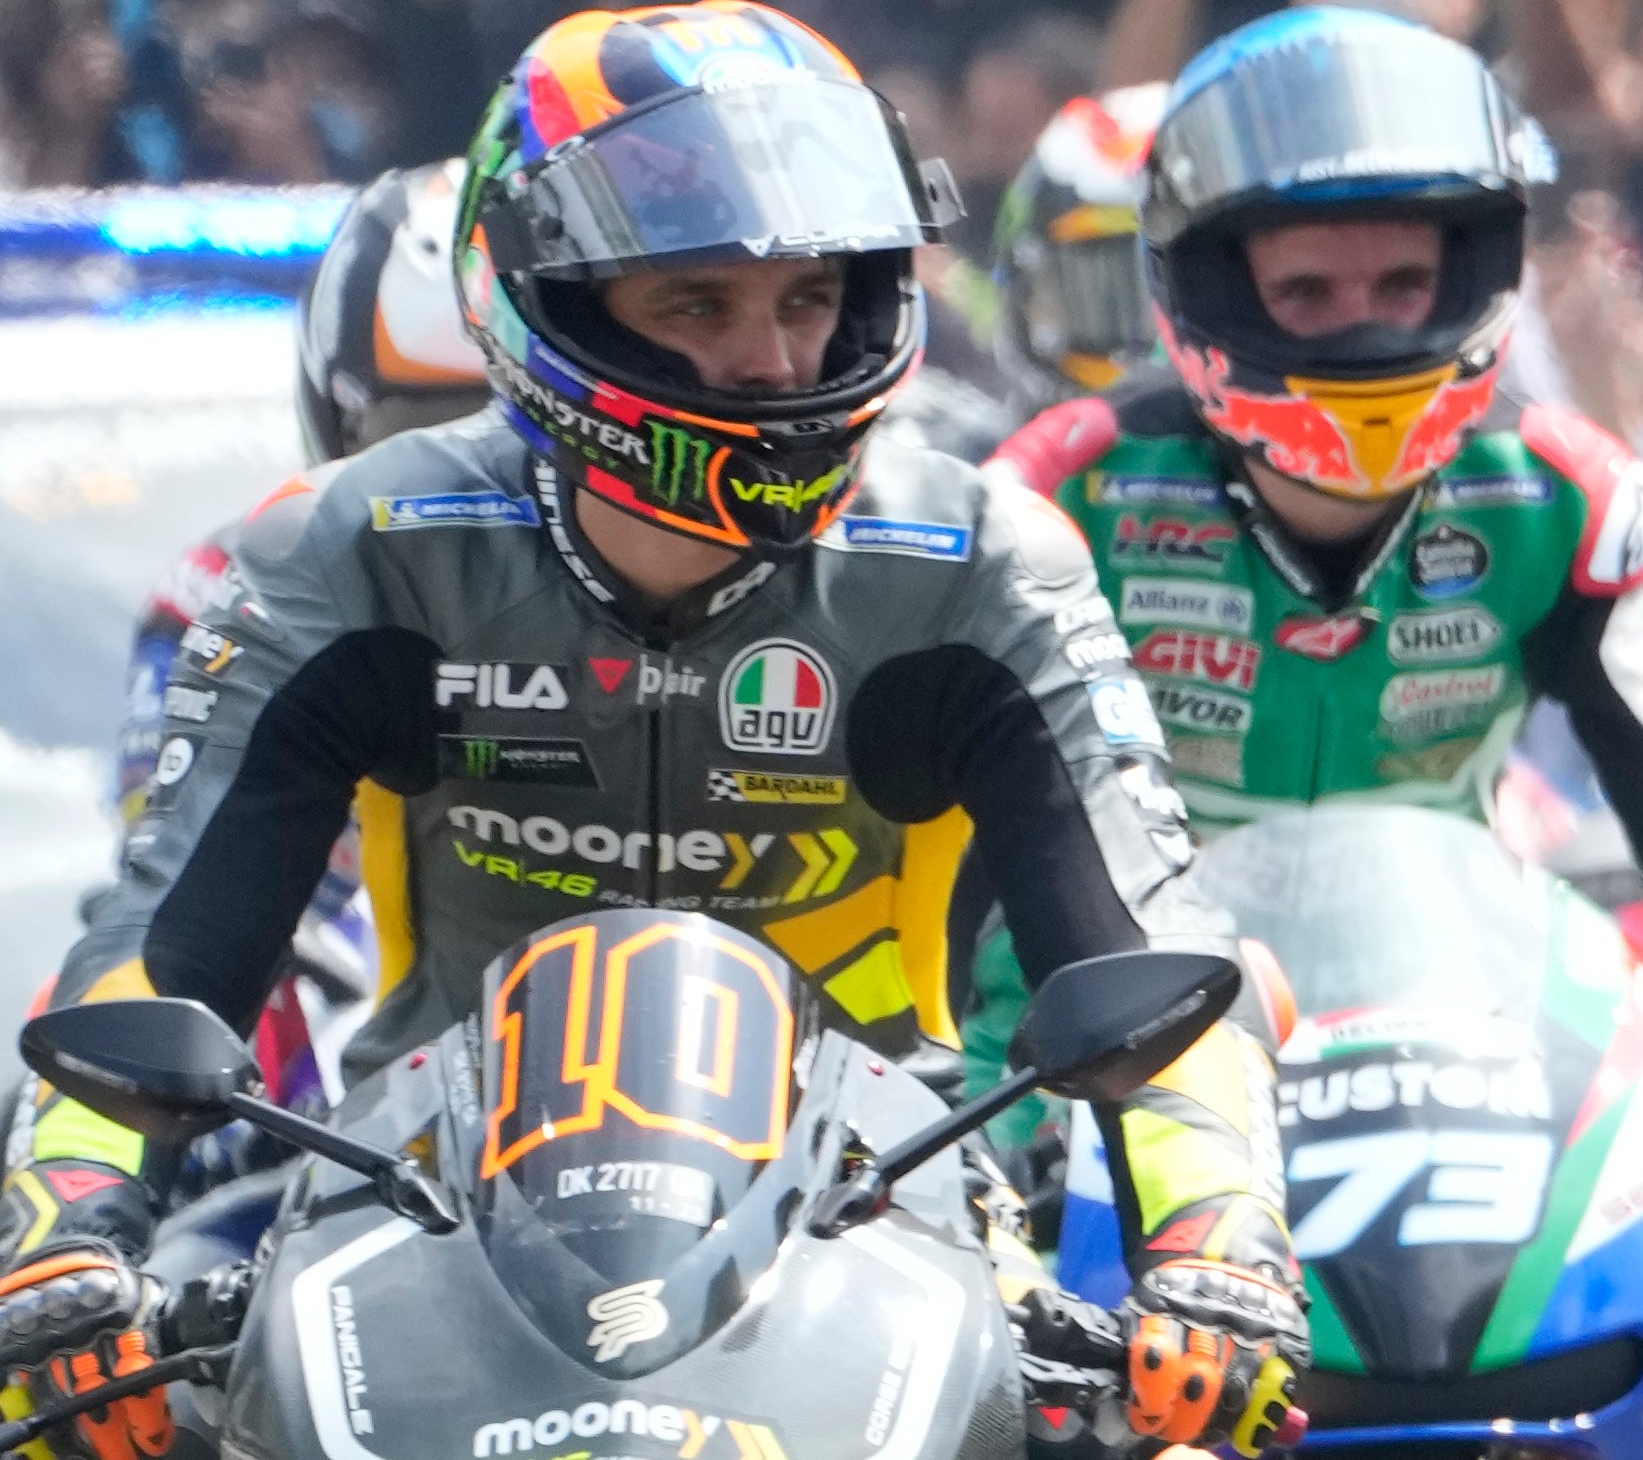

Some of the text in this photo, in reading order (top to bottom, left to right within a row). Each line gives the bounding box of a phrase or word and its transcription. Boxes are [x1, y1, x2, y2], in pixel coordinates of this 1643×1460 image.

[435, 663, 569, 711] FILA
[743, 773, 839, 799] BARDAHL
[446, 804, 775, 890] mooney
[481, 923, 794, 1180] 10
[556, 1165, 595, 1200] DK
[1286, 1129, 1555, 1262] 73
[331, 1284, 375, 1436] PANIGALE
[471, 1398, 722, 1460] mooney
